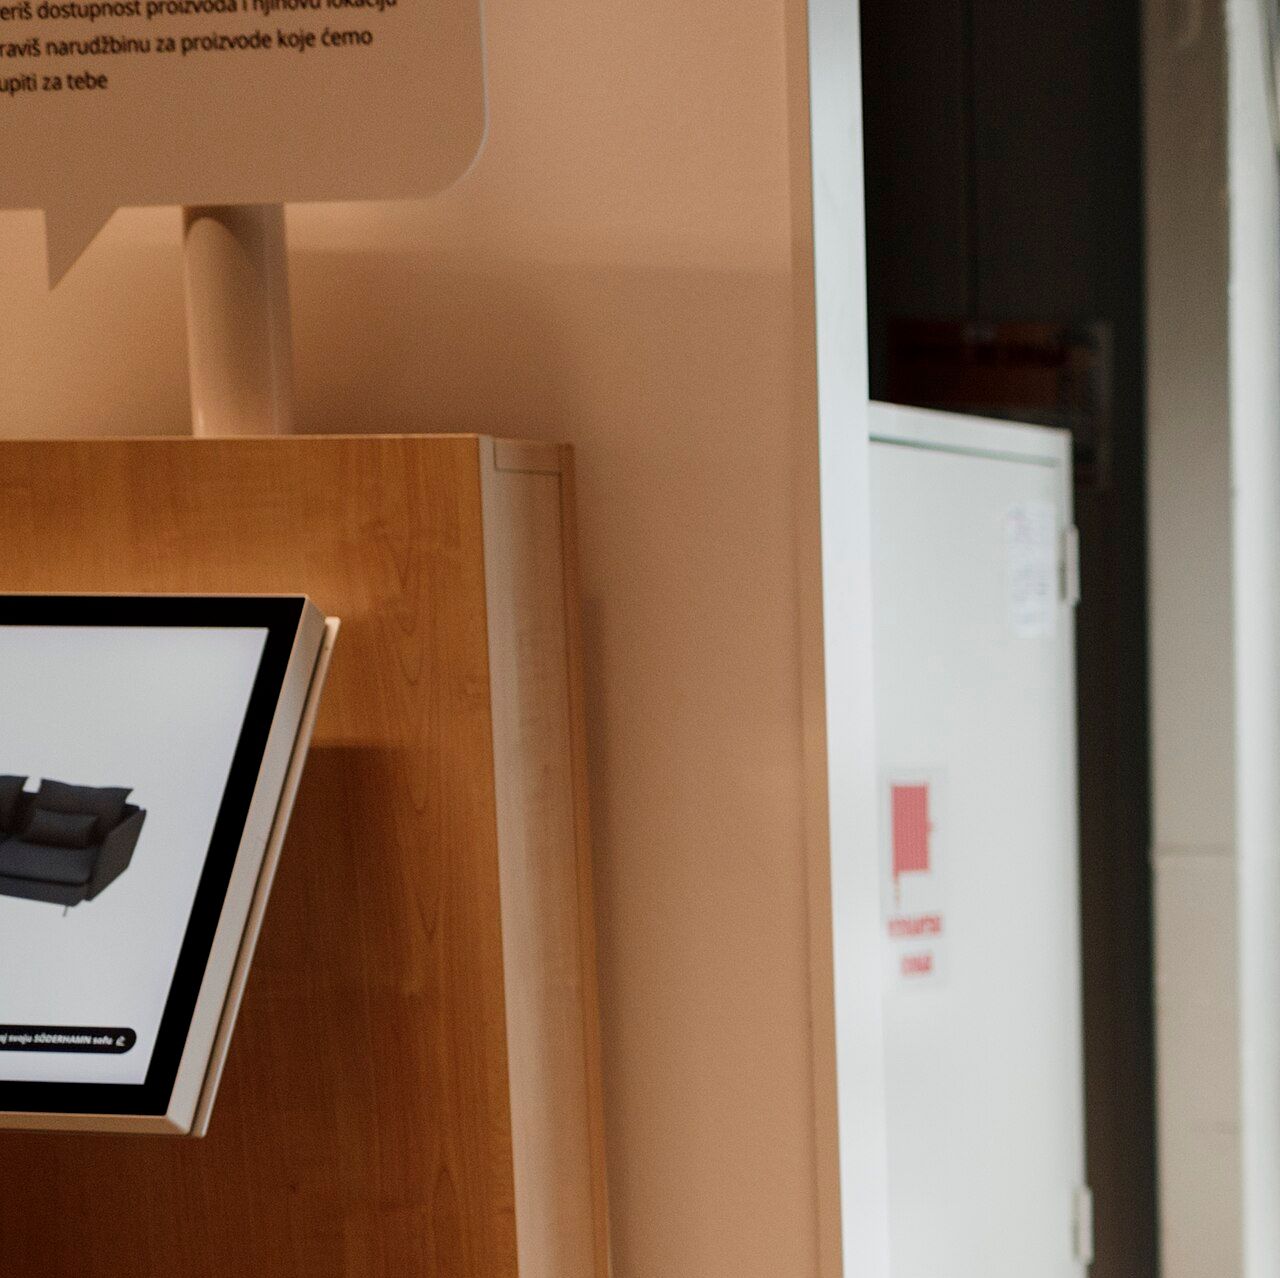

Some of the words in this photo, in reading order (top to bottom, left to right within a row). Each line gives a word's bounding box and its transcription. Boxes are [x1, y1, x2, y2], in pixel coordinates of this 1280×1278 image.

[37, 0, 141, 22] dostupnost
[147, 0, 237, 21] proizvoda
[46, 35, 151, 55] narudžbinu
[156, 38, 176, 52] za
[181, 31, 272, 56] proizvode
[277, 29, 316, 53] koje
[321, 27, 373, 46] ćemo
[42, 76, 62, 91] za
[67, 71, 108, 91] tebe
